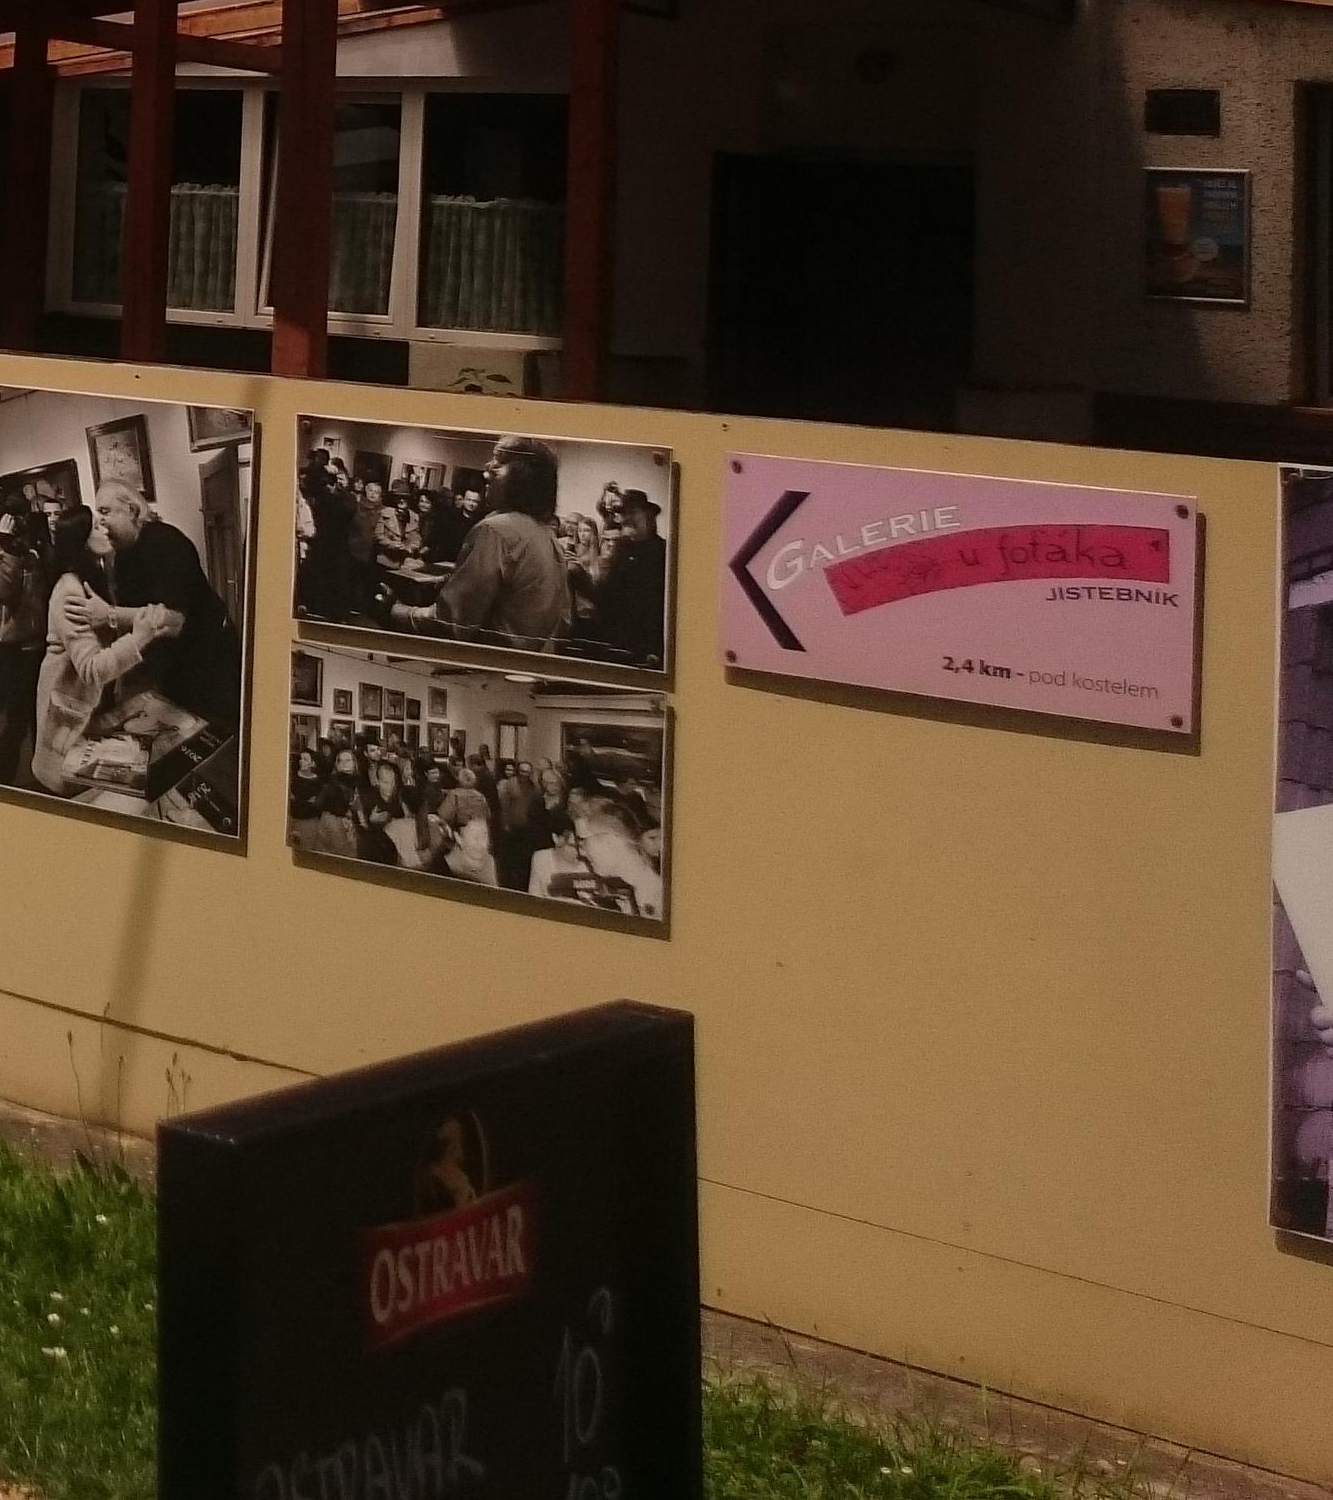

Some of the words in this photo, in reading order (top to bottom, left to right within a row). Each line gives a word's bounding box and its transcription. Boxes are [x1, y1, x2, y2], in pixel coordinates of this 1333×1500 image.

[941, 656, 975, 675] 2,4
[1028, 669, 1066, 687] pod
[1071, 672, 1159, 699] kostelem
[370, 1203, 526, 1324] OSTRAVAR
